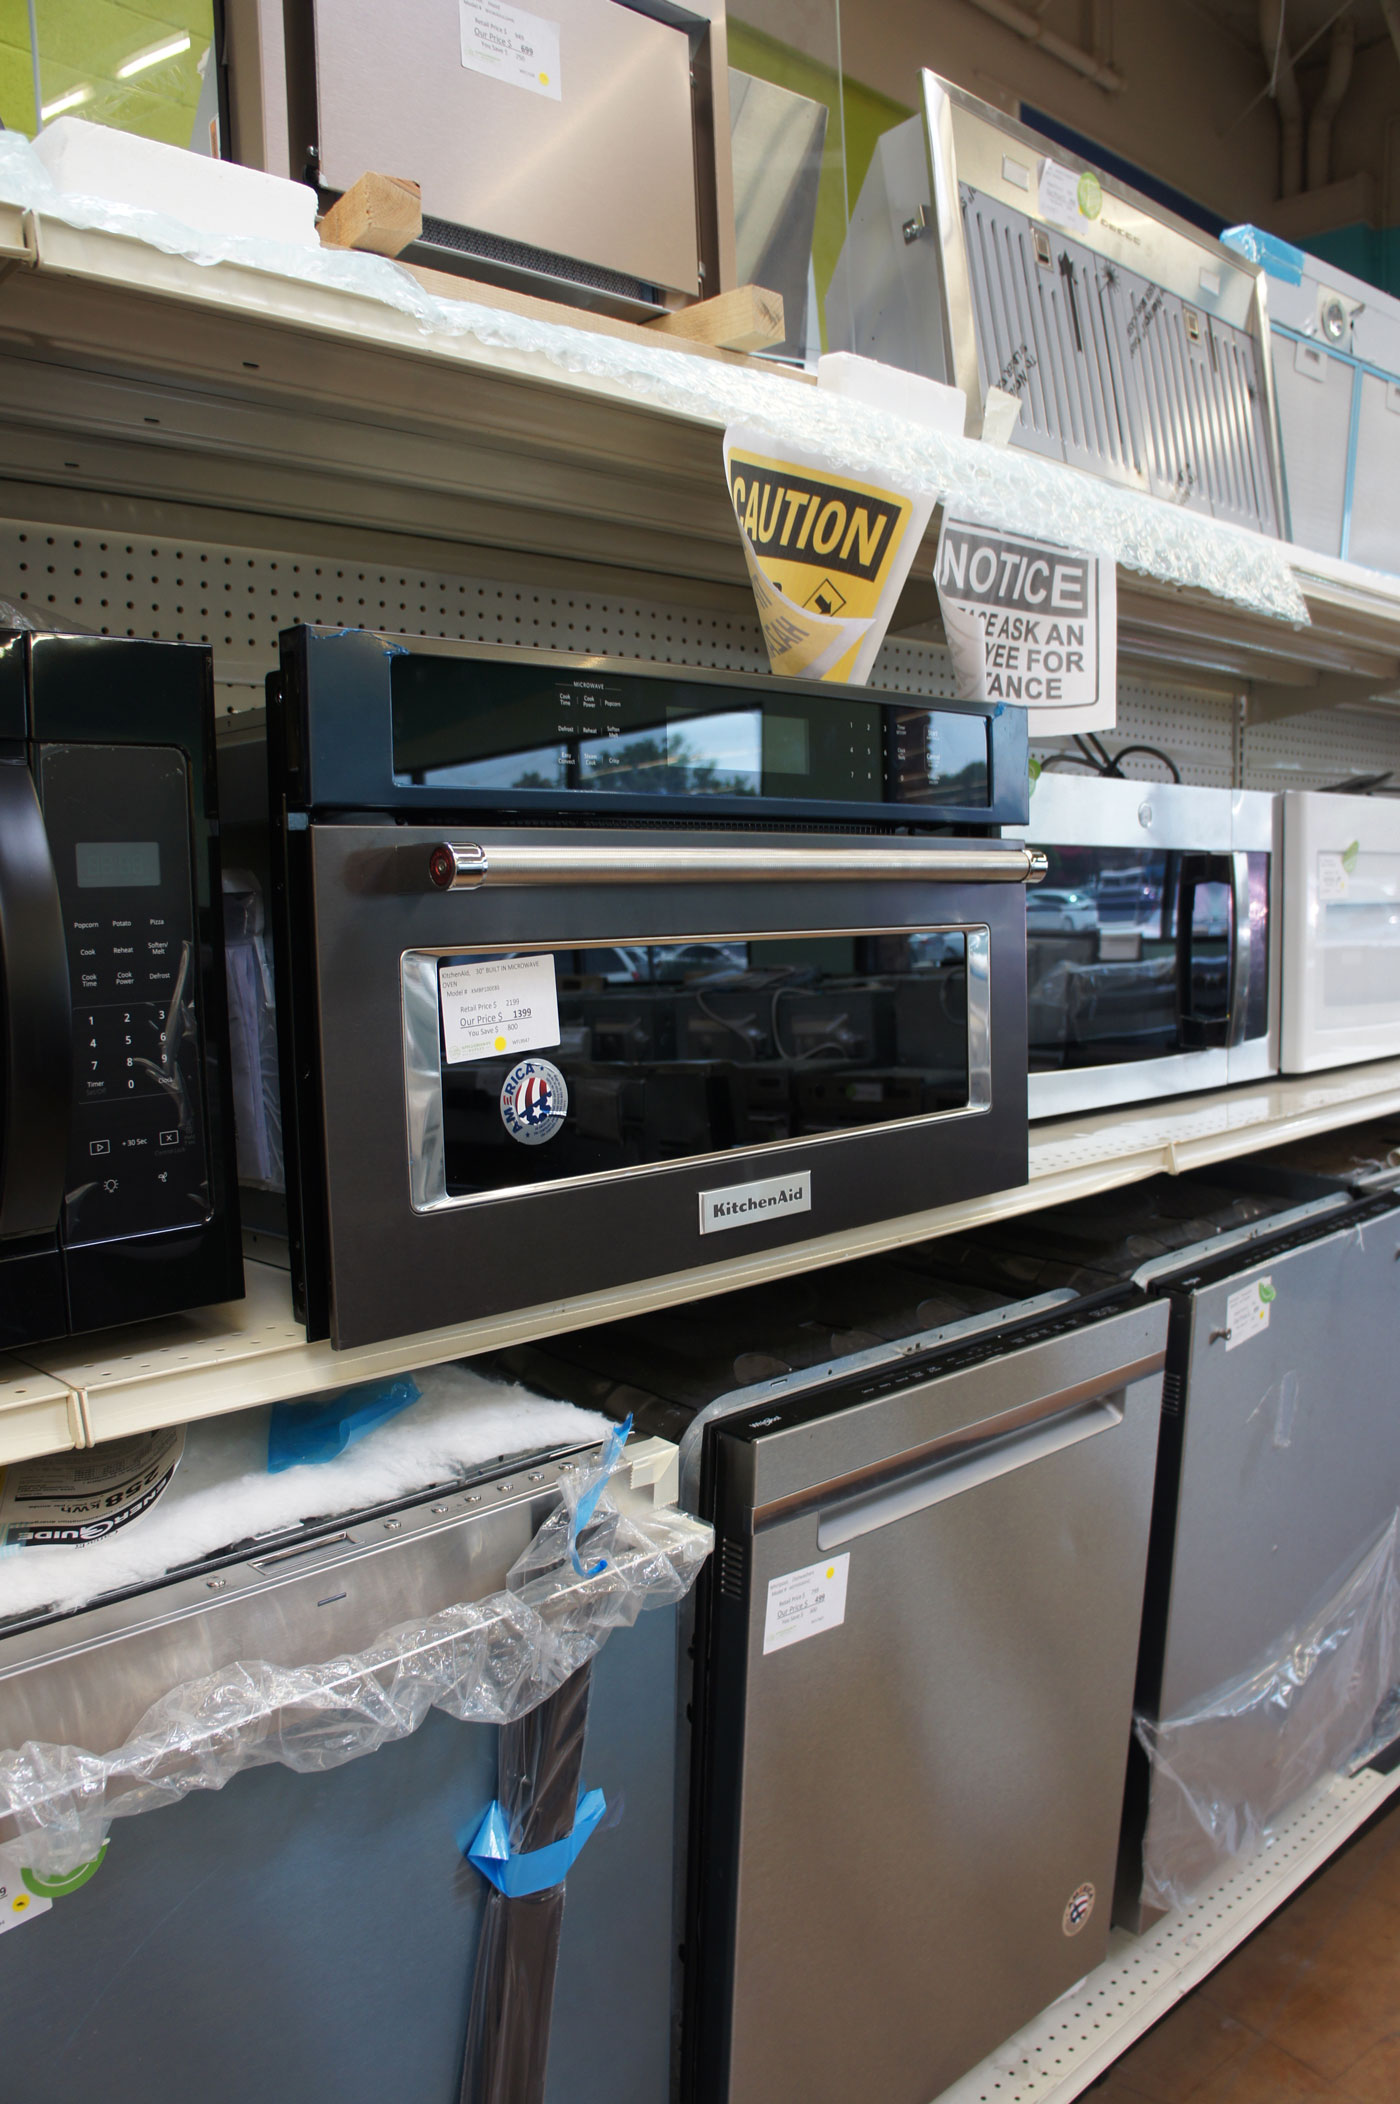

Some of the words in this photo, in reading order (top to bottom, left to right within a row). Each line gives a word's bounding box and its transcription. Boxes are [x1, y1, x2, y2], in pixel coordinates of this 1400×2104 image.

[474, 27, 487, 39] Our
[489, 33, 506, 47] Price
[520, 44, 534, 56] 699
[733, 476, 888, 567] CAUTION
[941, 538, 1083, 610] NOTICE
[998, 615, 1041, 645] ASK
[1045, 624, 1084, 647] AN
[1027, 651, 1085, 673] FOR
[573, 681, 604, 690] MICROWAVE
[507, 961, 539, 970] MICROWAVE
[442, 981, 458, 989] OVEN
[446, 989, 464, 997] Model
[460, 1004, 477, 1013] Retail
[478, 1002, 492, 1011] Price
[506, 998, 520, 1006] 2199
[89, 1016, 94, 1025] 1
[124, 1013, 130, 1023] 2
[159, 1010, 165, 1019] 3
[460, 1017, 475, 1027] Our
[477, 1014, 496, 1025] Price
[498, 1012, 503, 1022] $
[513, 1008, 532, 1019] 1399
[468, 1028, 479, 1037] You
[480, 1026, 494, 1035] Save
[90, 1039, 97, 1048] 4
[125, 1035, 132, 1045] 5
[160, 1032, 167, 1041] 6
[91, 1061, 98, 1070] 7
[126, 1057, 133, 1067] 8
[161, 1054, 168, 1063] 9
[128, 1080, 135, 1089] 0
[503, 1063, 535, 1133] AMERICA
[127, 1139, 136, 1147] 30
[136, 1138, 148, 1146] Sec
[713, 1187, 803, 1218] KitchenAid
[61, 1503, 100, 1514] kWh
[777, 1609, 787, 1618] Our
[789, 1604, 803, 1613] Price
